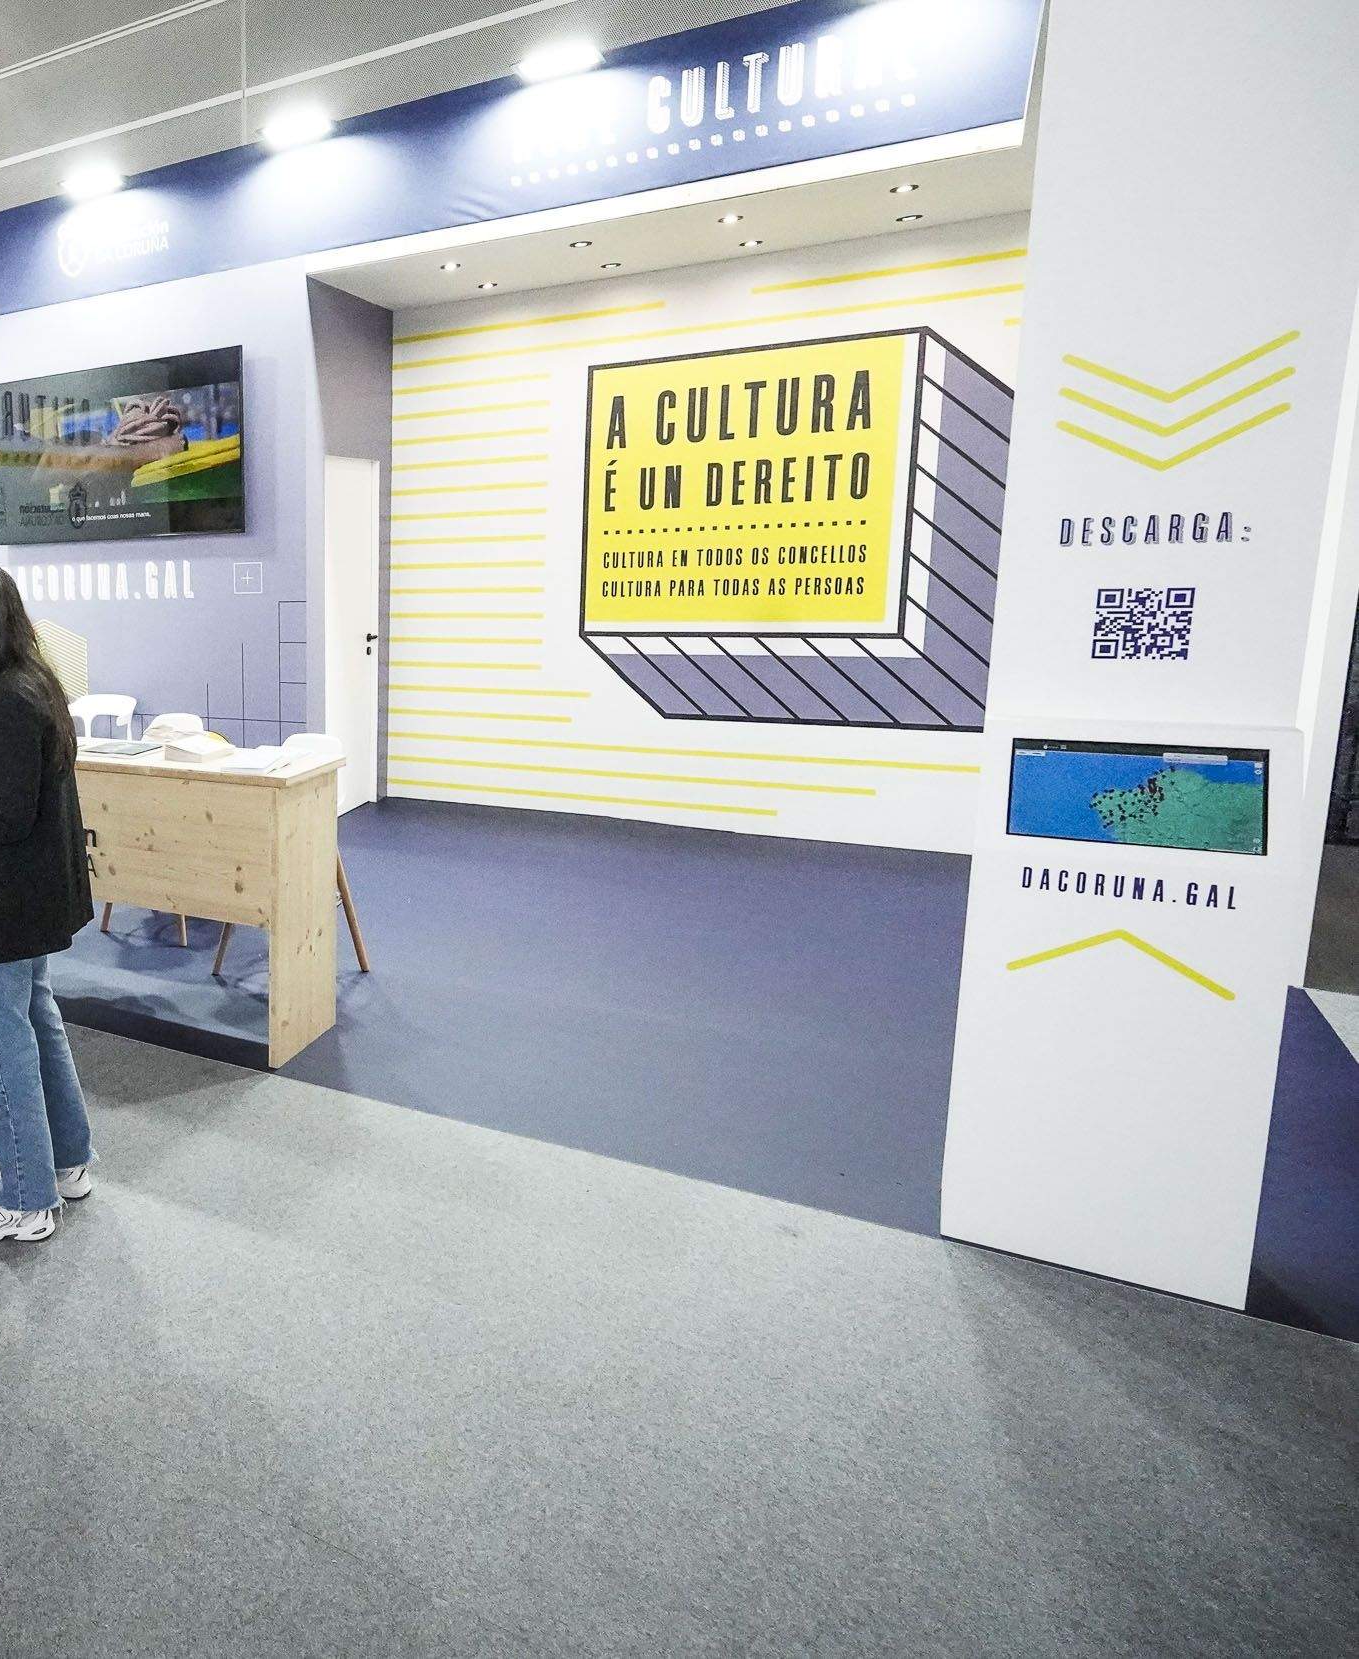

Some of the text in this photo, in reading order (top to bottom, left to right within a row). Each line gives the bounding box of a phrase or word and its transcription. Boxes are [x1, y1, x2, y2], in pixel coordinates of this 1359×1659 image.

[606, 369, 871, 450] A CULTURA
[604, 452, 870, 512] É UN DEREITO
[1059, 511, 1252, 547] DESCARGA:
[603, 544, 867, 569] CULTURA EN TODOS OS CONCELLOS
[602, 576, 864, 598] CULTURA PARA TODAS AS PERSOAS
[1021, 866, 1237, 910] DACORUNA.GAL
